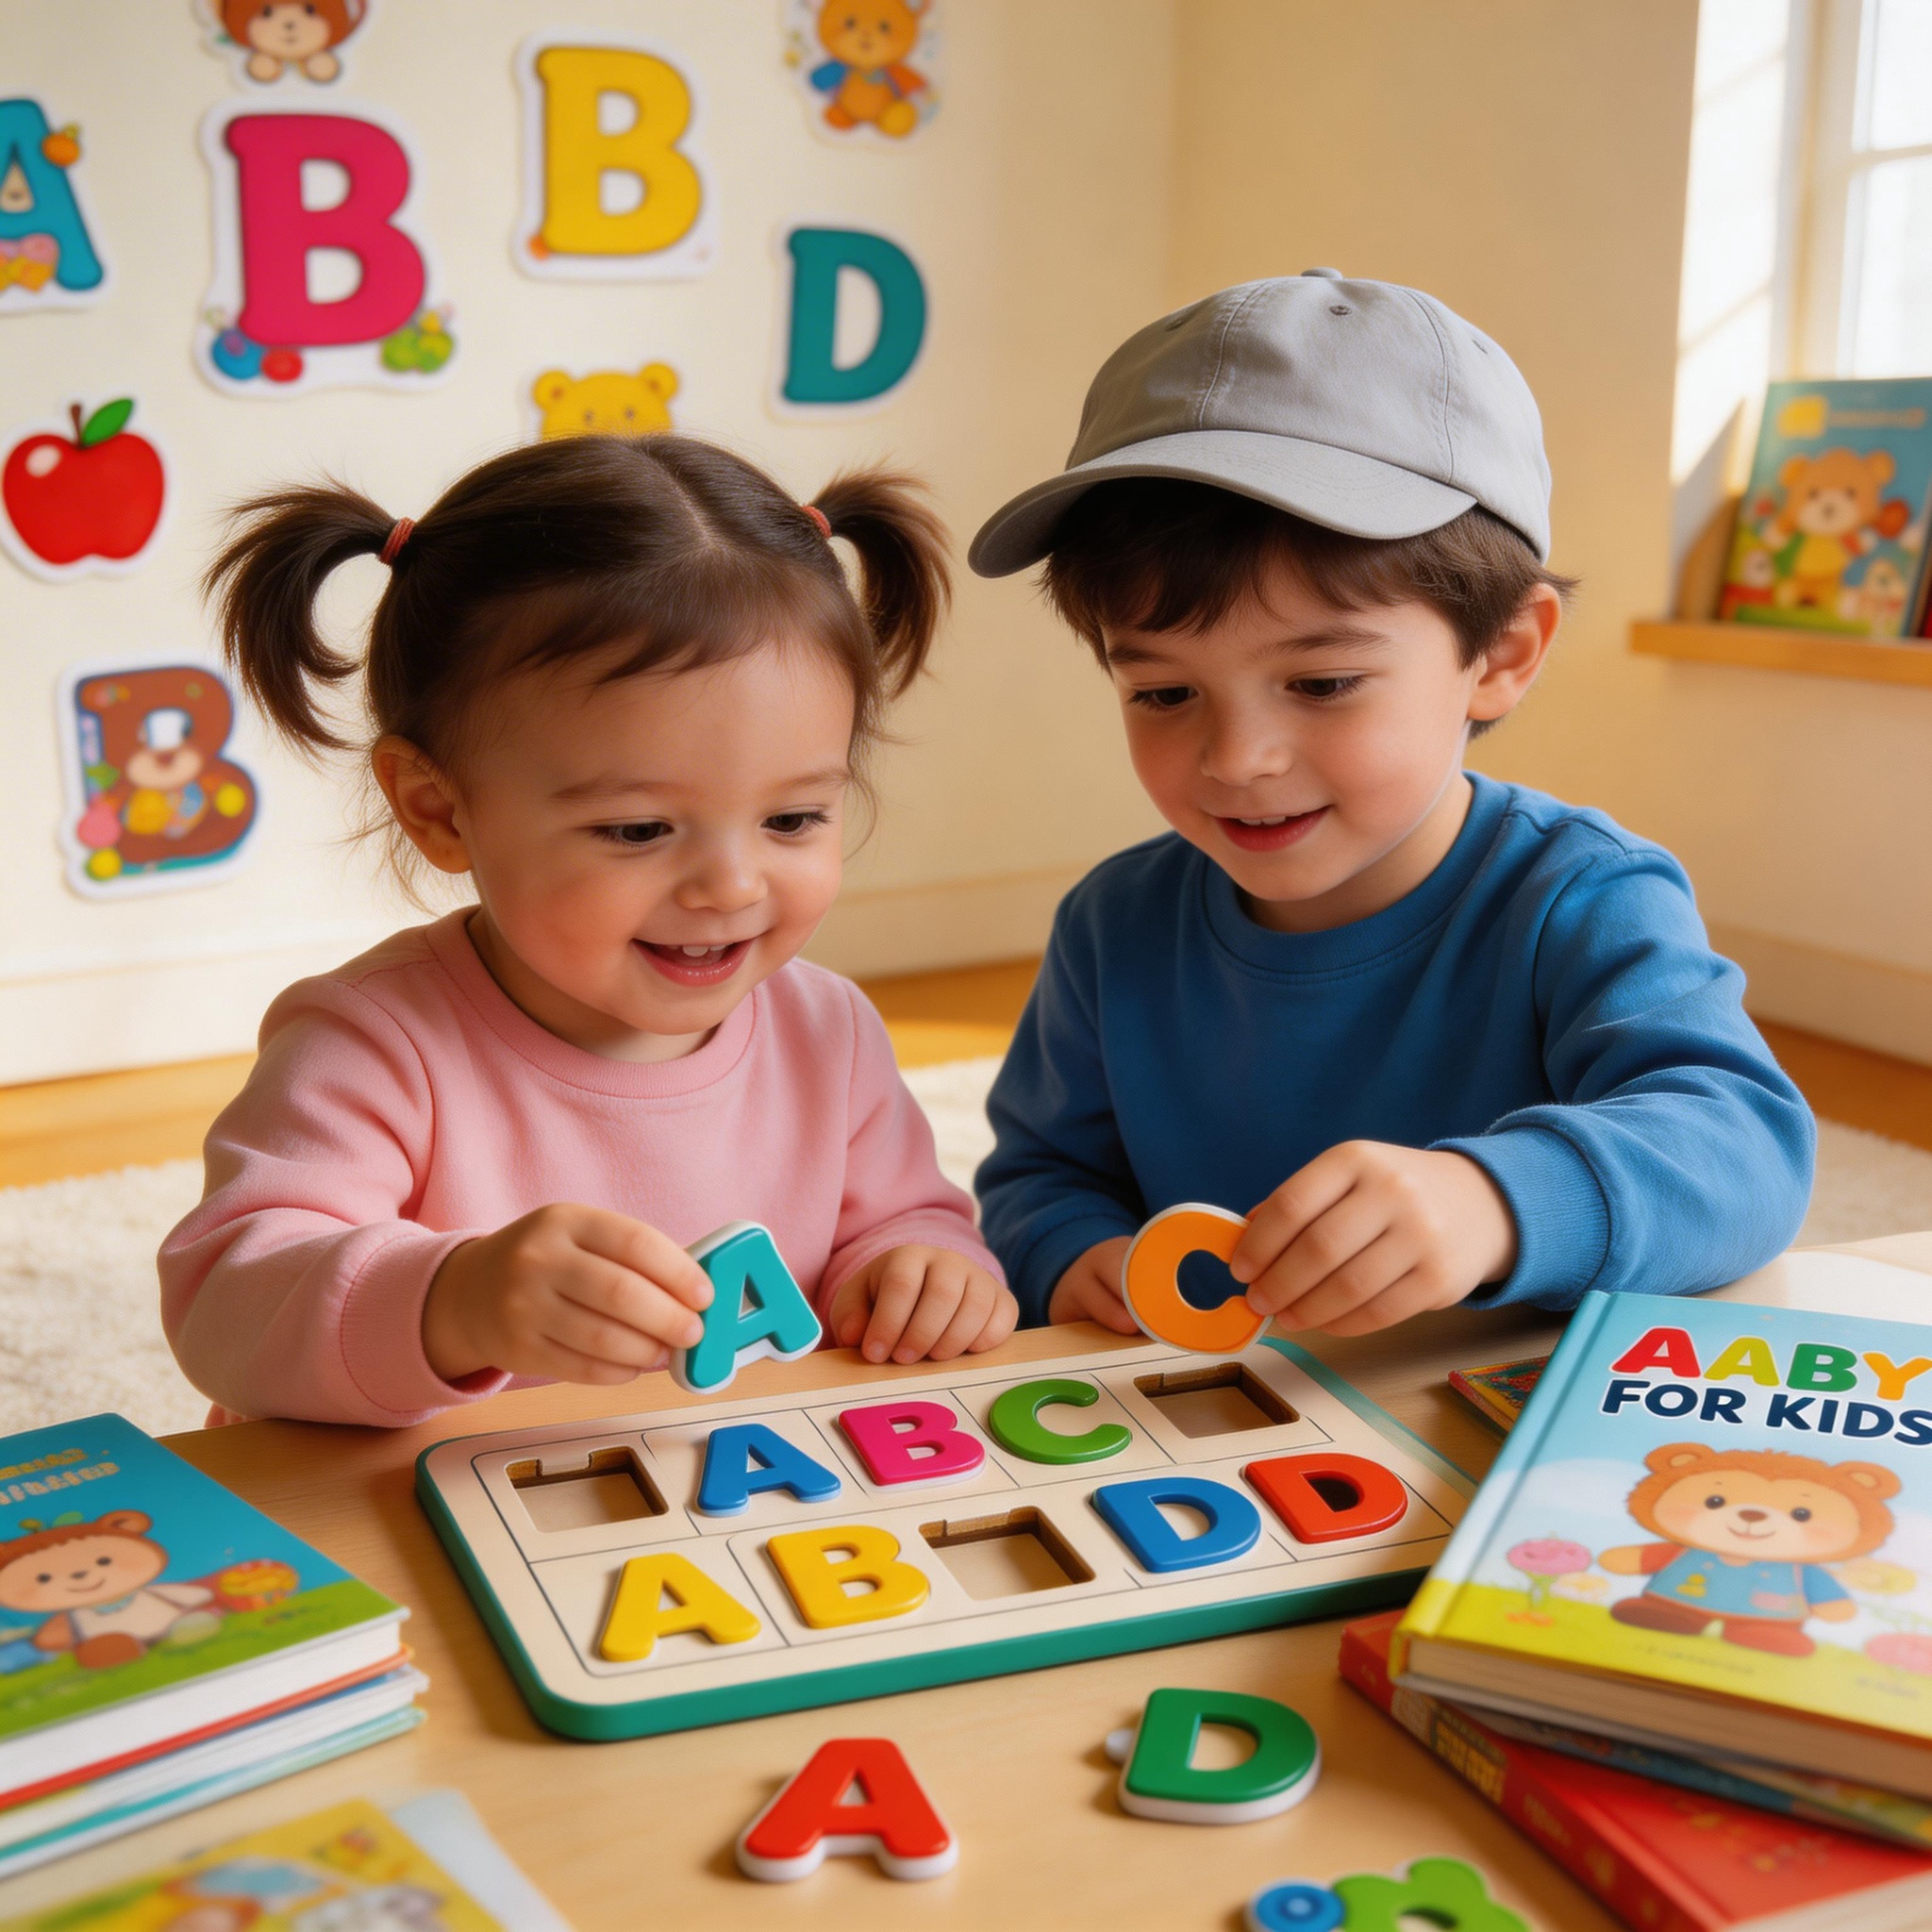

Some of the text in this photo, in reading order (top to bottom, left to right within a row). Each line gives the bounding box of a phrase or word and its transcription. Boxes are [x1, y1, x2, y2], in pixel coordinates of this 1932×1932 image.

[0, 99, 102, 290] A
[225, 114, 426, 347] B
[535, 46, 702, 255] B
[782, 227, 926, 403] D
[74, 665, 257, 877] B
[685, 1226, 820, 1391] A
[1124, 1204, 1269, 1355] C
[1601, 1378, 1932, 1446] FOR KIDS
[1609, 1325, 1932, 1401] AABY
[697, 1377, 1132, 1517] A B C
[598, 1453, 1408, 1663] A B D D
[740, 1737, 955, 1864] A
[1123, 1687, 1319, 1806] D
